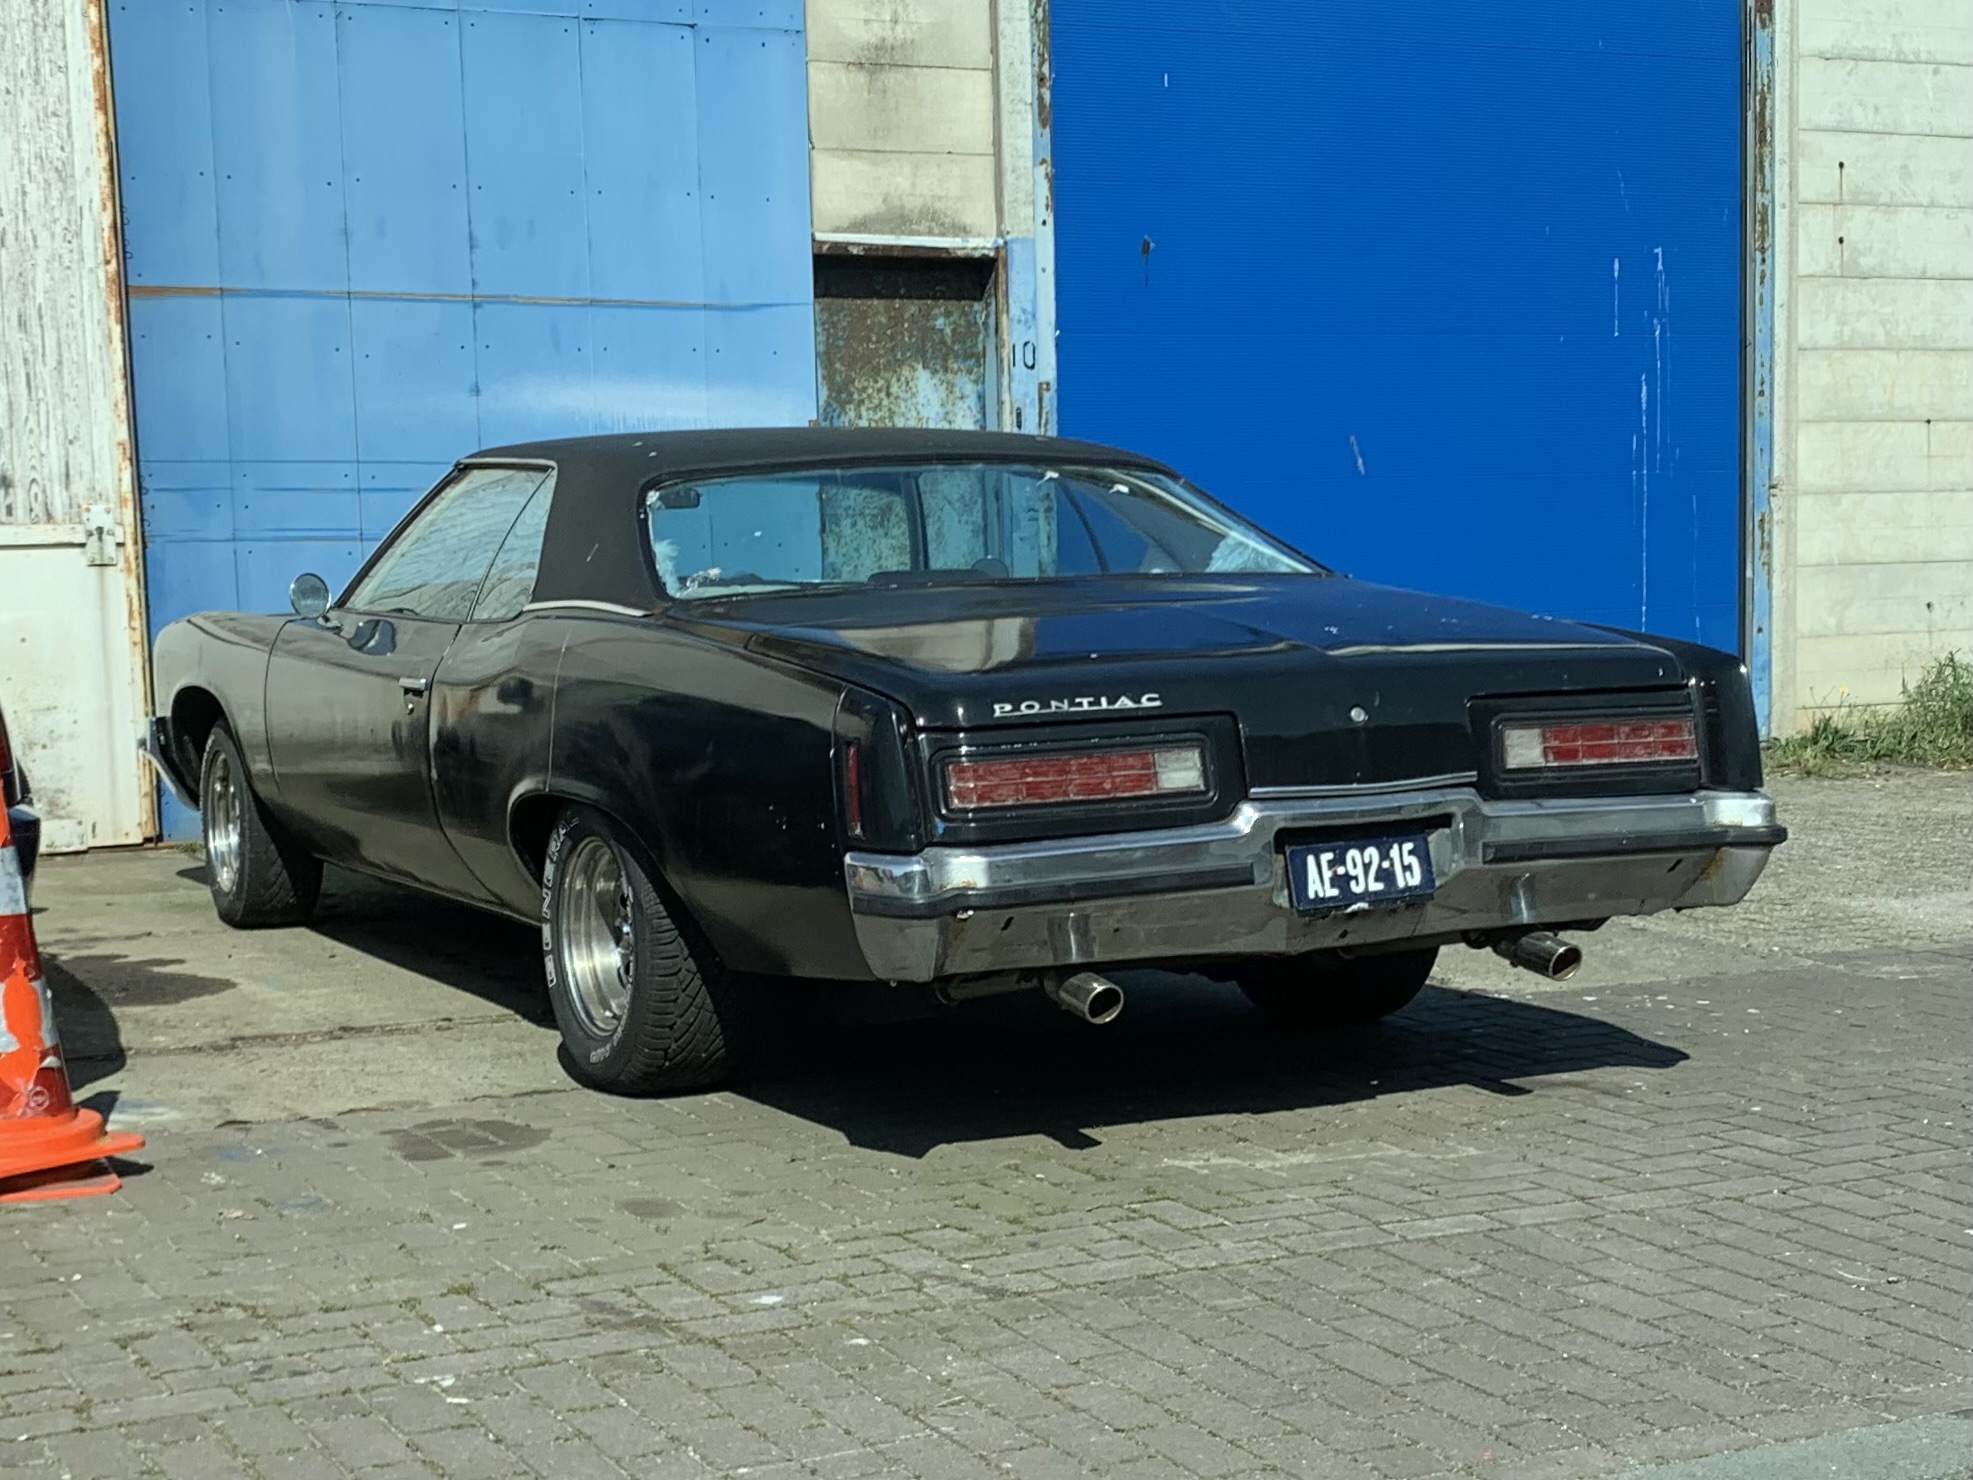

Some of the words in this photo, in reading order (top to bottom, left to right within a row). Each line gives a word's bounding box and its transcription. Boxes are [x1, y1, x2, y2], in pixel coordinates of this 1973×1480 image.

[1012, 340, 1036, 370] 10
[993, 693, 1163, 717] PONTIAC
[1306, 841, 1422, 899] AE-92-15
